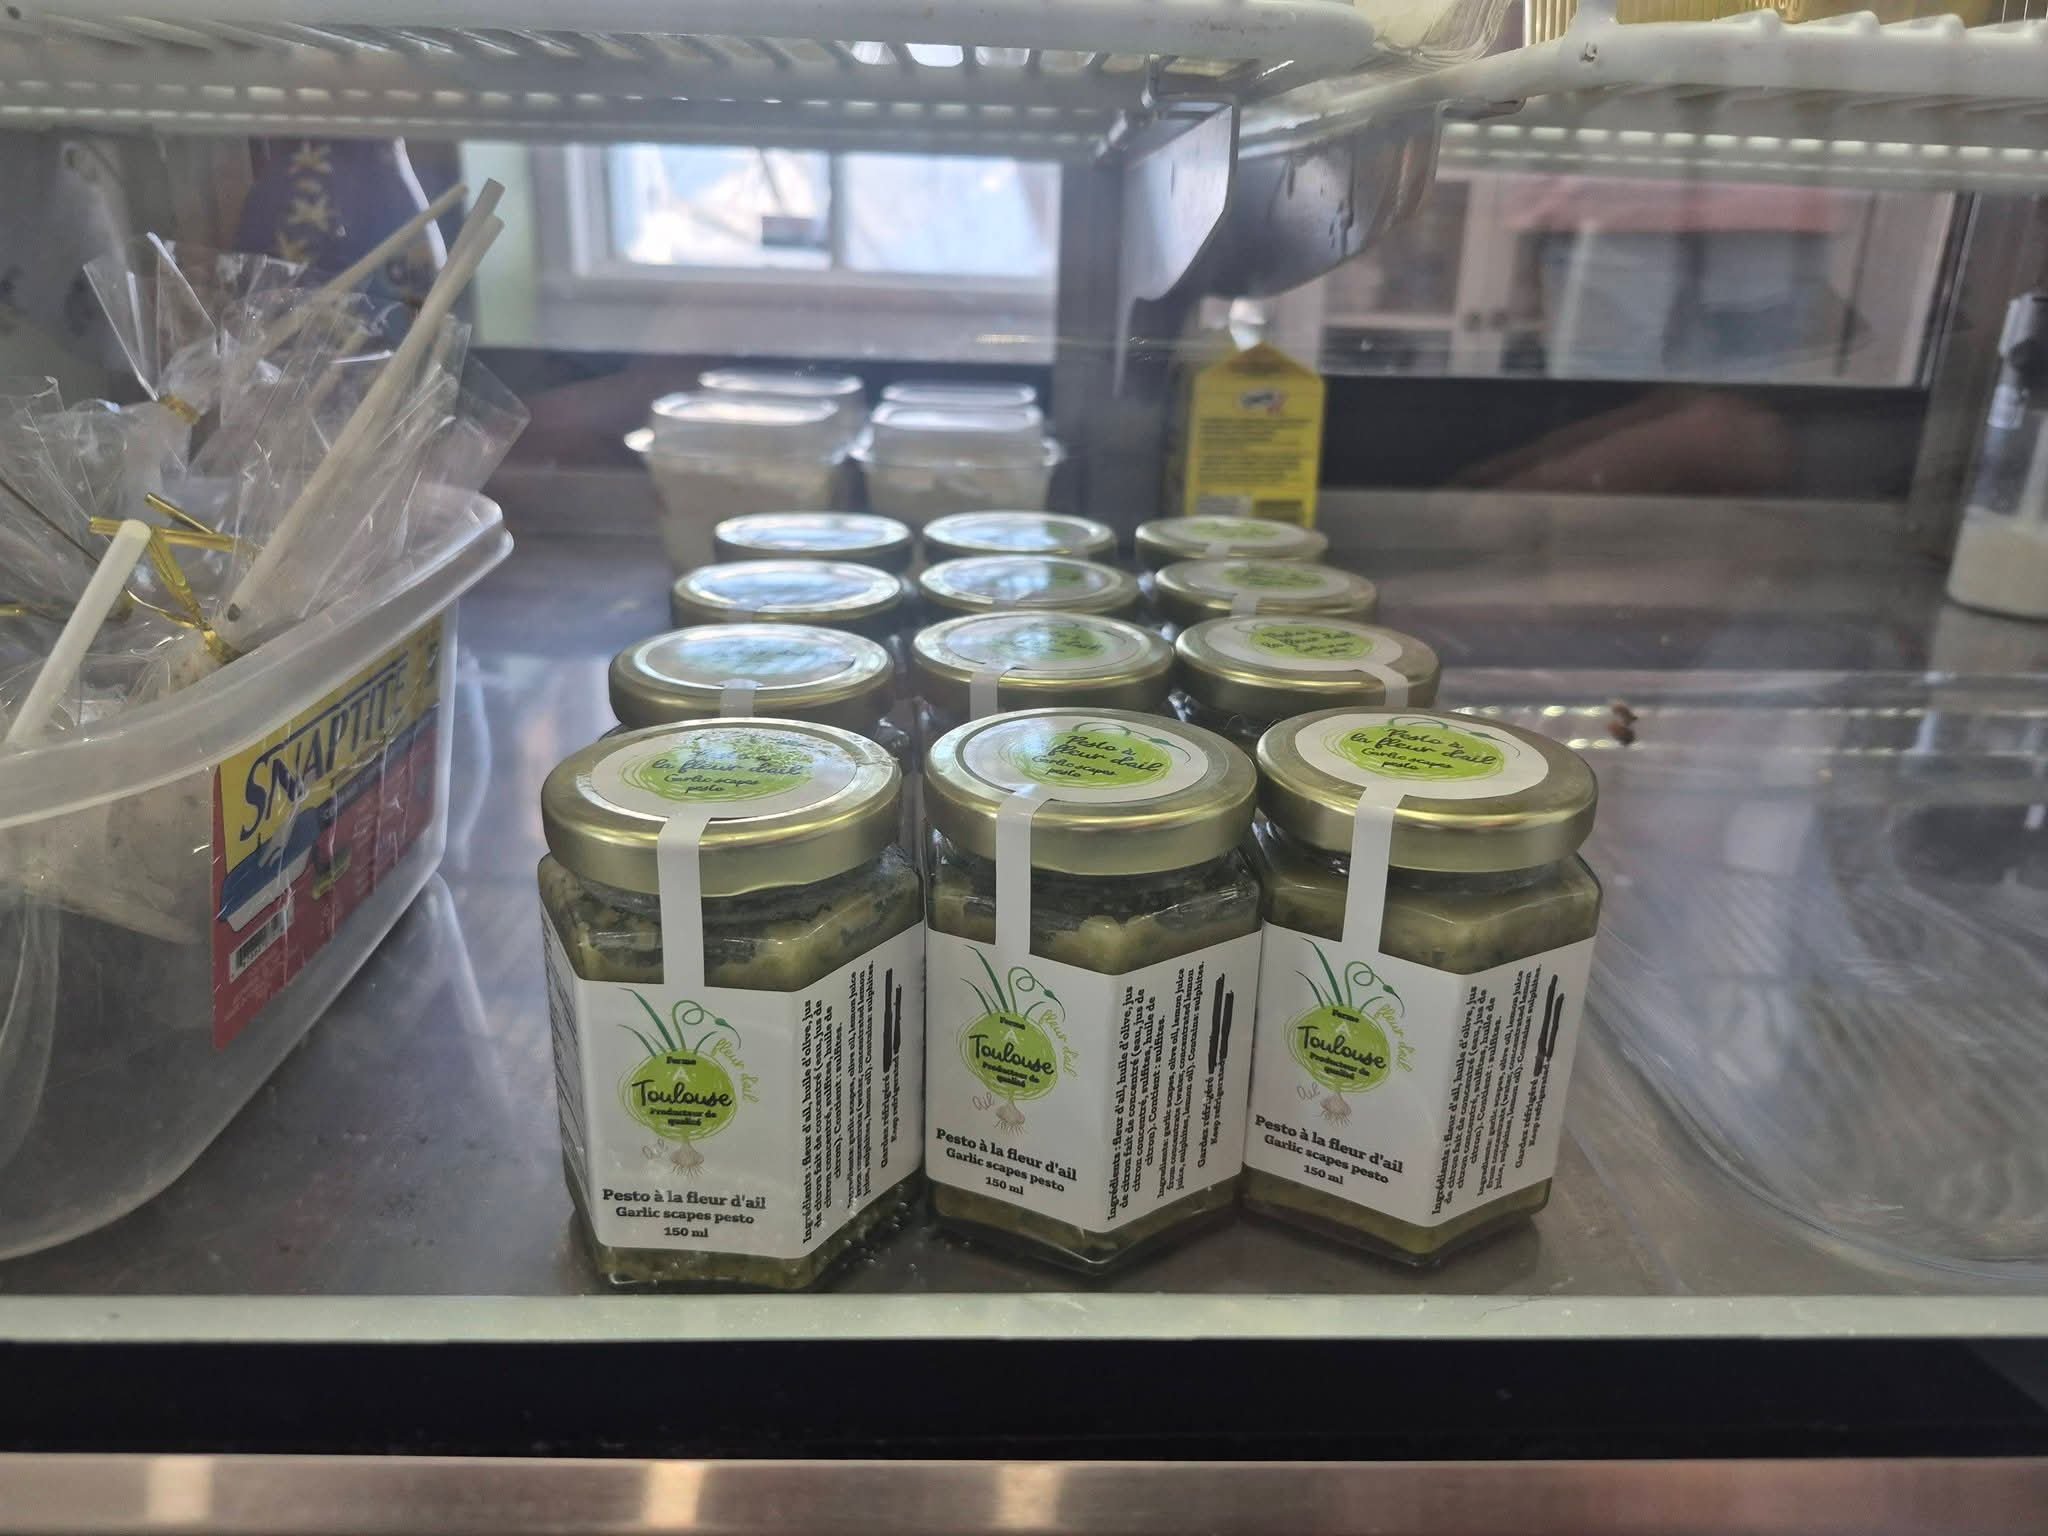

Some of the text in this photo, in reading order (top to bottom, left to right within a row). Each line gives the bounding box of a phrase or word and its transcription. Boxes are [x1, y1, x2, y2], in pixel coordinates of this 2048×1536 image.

[1174, 968, 1184, 994] juice
[1183, 969, 1194, 1002] lemon
[1172, 995, 1182, 1028] lemon
[1171, 1028, 1180, 1044] oil,
[1297, 1025, 1386, 1068] Toulouse
[968, 1034, 1054, 1075] Toulouse
[1168, 1047, 1177, 1070] olive
[631, 1079, 733, 1107] Toulouse
[1107, 986, 1133, 1220] Ingrédients fleur d'ail, huile d'olive, jus
[1120, 989, 1144, 1208] de citron fait de concentré (eau, jus de
[1132, 996, 1155, 1192] citron concentré, sulfites, huile de
[1145, 1015, 1165, 1166] citron). Contient sulfites.
[936, 1128, 1077, 1181] Pesto à la fleur d'ail
[1197, 1128, 1208, 1168] Gardez
[1255, 1114, 1403, 1173] Pesto à la fleur d'ail
[1264, 1135, 1389, 1184] Garlic scapes pesto
[946, 1148, 1064, 1192] Garlic scapes pesto
[985, 1176, 1024, 1195] 150 ml
[1304, 1165, 1343, 1184] 150 ml
[602, 1189, 767, 1209] Pesto à la fleur d'ail
[616, 1206, 755, 1224] Garlic scapes pesto
[664, 1227, 709, 1238] 150 ml
